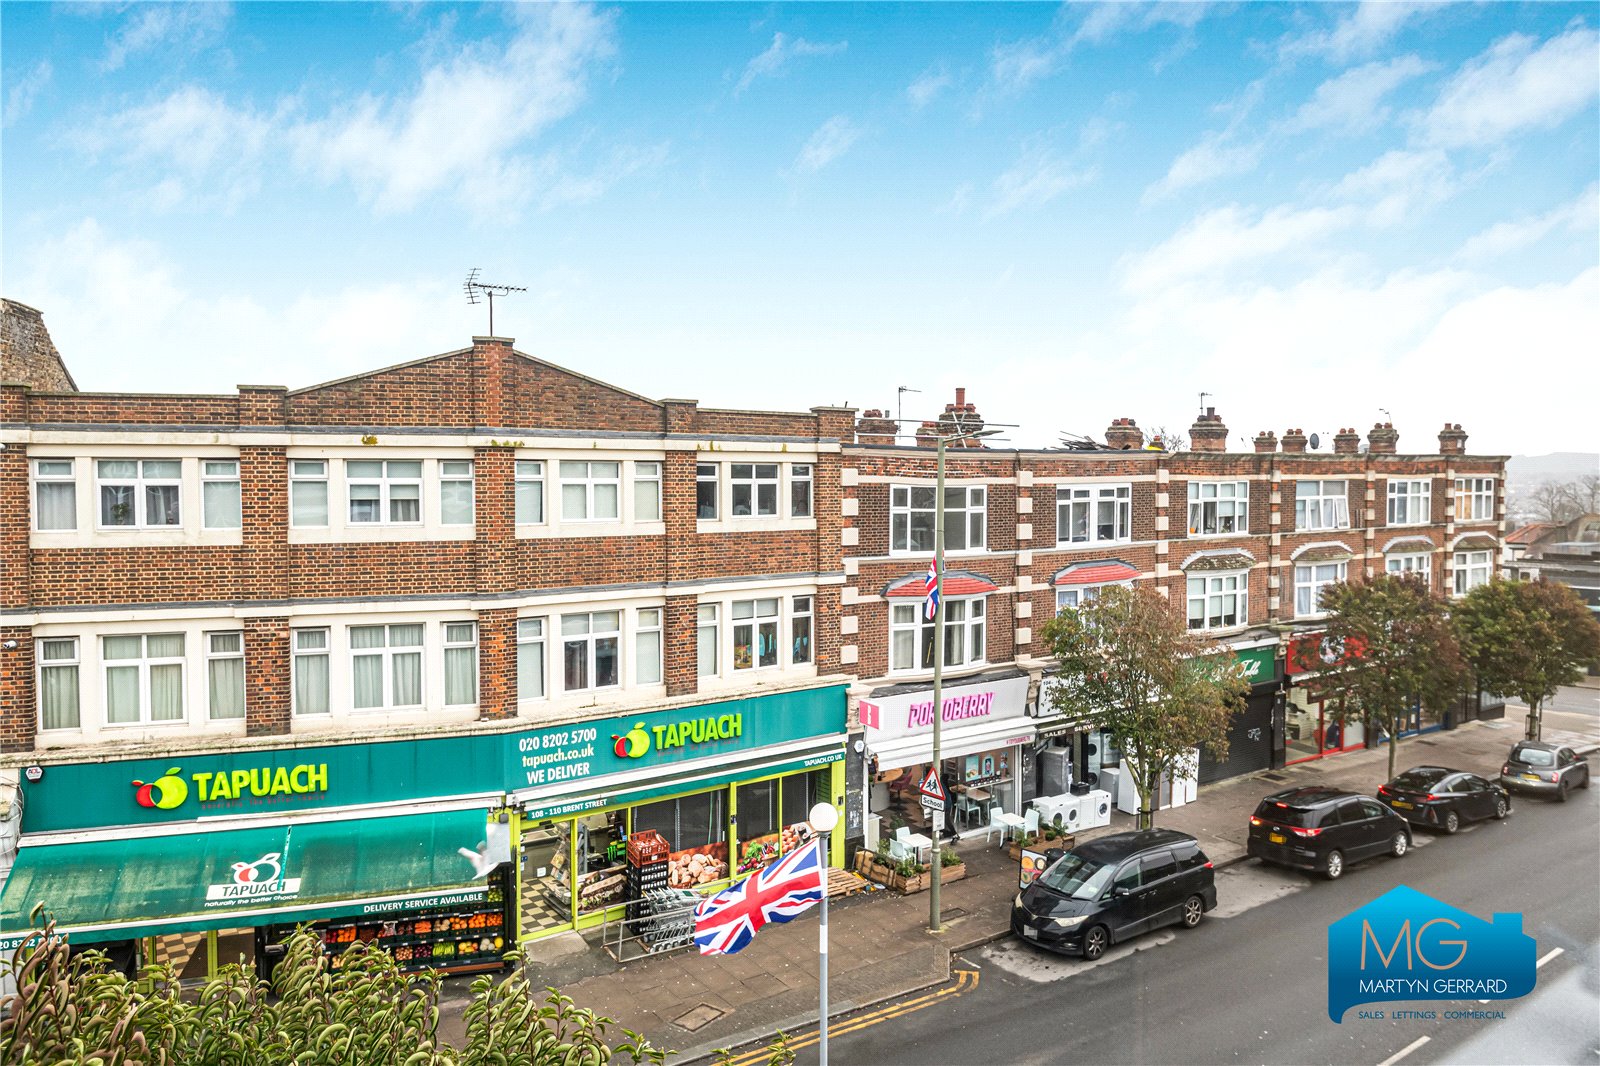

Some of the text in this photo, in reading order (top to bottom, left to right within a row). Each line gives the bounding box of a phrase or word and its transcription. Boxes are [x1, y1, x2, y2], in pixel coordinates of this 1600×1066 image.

[907, 692, 995, 728] POROBERRY
[519, 728, 597, 752] 020 8202 5700
[652, 713, 742, 750] TAPUACH
[1044, 729, 1066, 738] SALES
[522, 743, 595, 768] tapuach.co.uk
[192, 763, 327, 801] TAPUACH
[526, 762, 590, 785] WE DELIVER
[531, 810, 544, 819] 108
[549, 807, 561, 816] 110
[562, 802, 584, 813] BRENT
[584, 799, 608, 809] STREET
[923, 796, 943, 809] School
[222, 881, 286, 897] TAPUACH
[204, 900, 237, 908] naturally
[251, 895, 273, 903] better
[363, 893, 483, 913] DELIVERY SERVICE AVAILABLE
